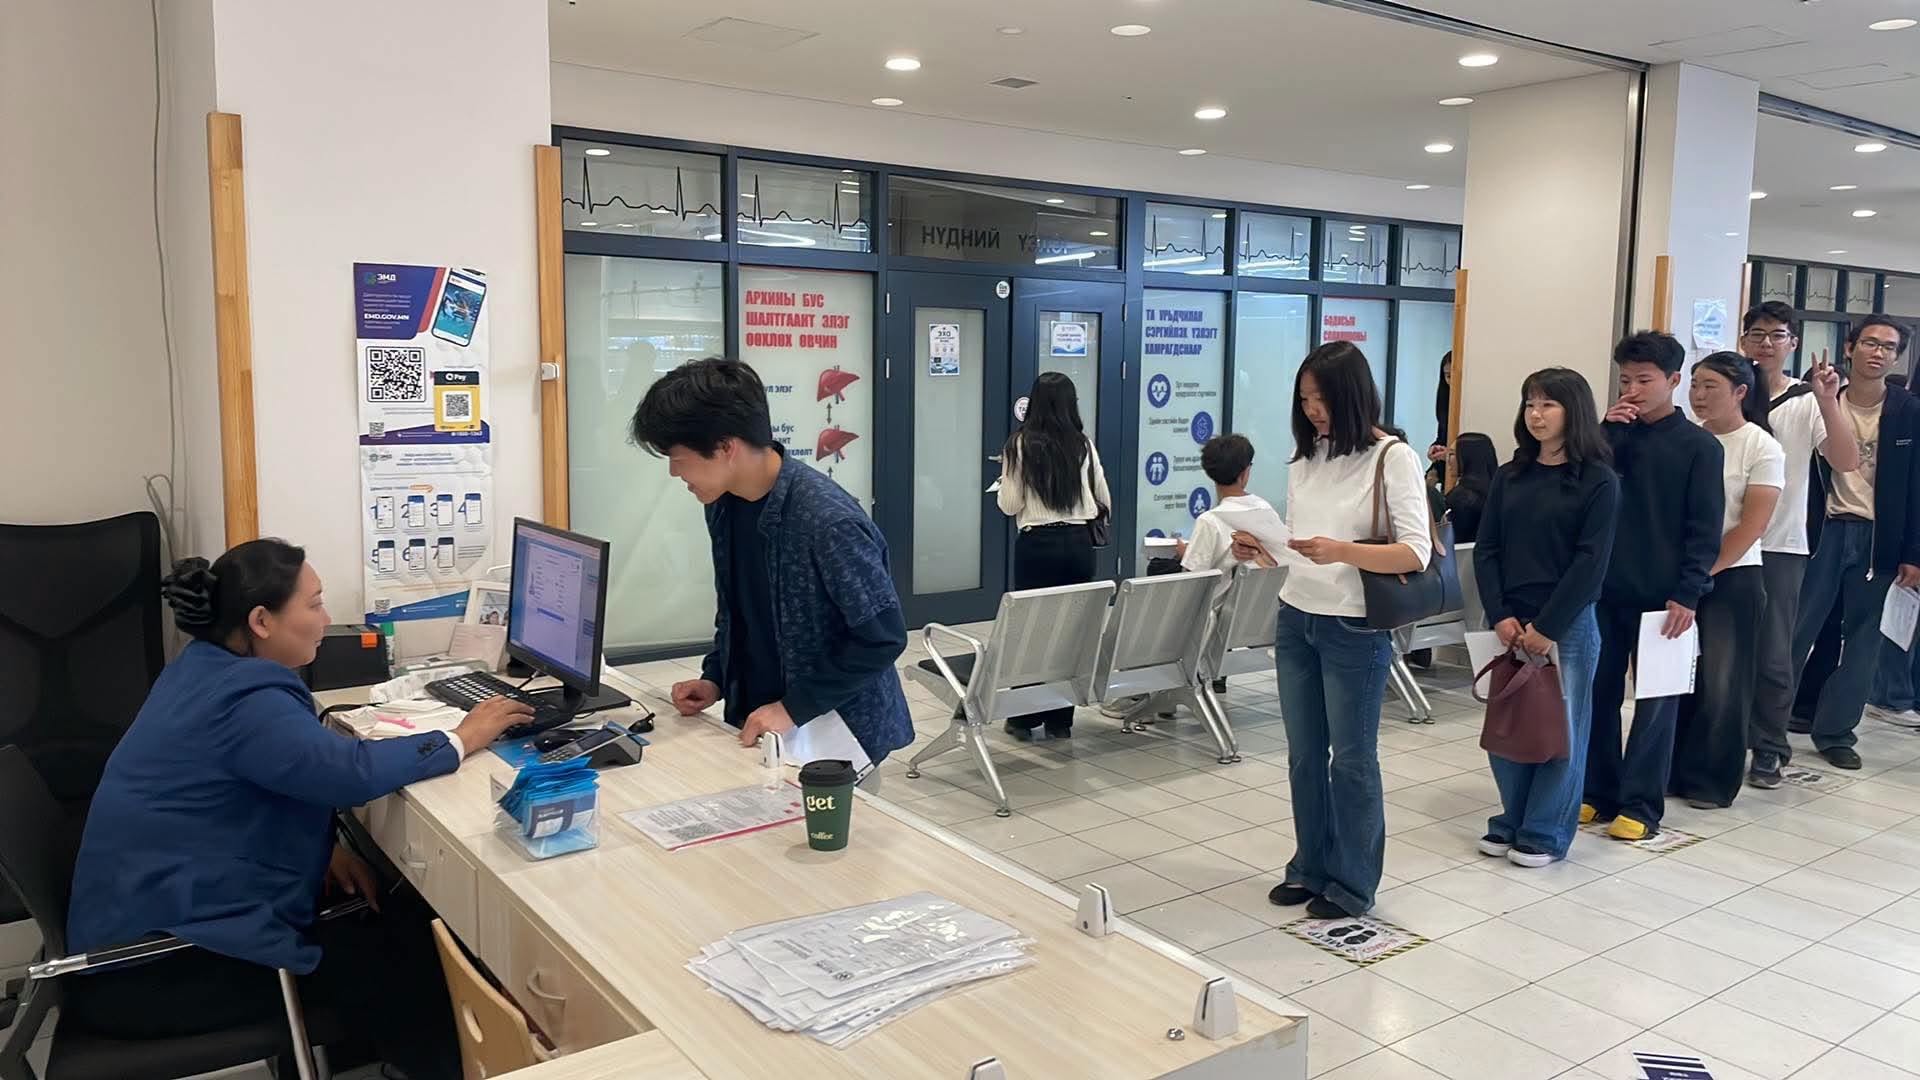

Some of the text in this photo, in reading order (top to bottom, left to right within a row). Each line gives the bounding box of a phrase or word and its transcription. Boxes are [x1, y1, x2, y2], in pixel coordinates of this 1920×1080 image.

[921, 225, 1000, 250] НҮДНИЙ
[746, 290, 824, 308] АРХИНЫ БУС
[746, 312, 850, 329] ШАЛТГААНТ ЭЛЭГ
[1146, 309, 1155, 321] ТА
[782, 423, 794, 434] бус
[806, 795, 836, 812] get
